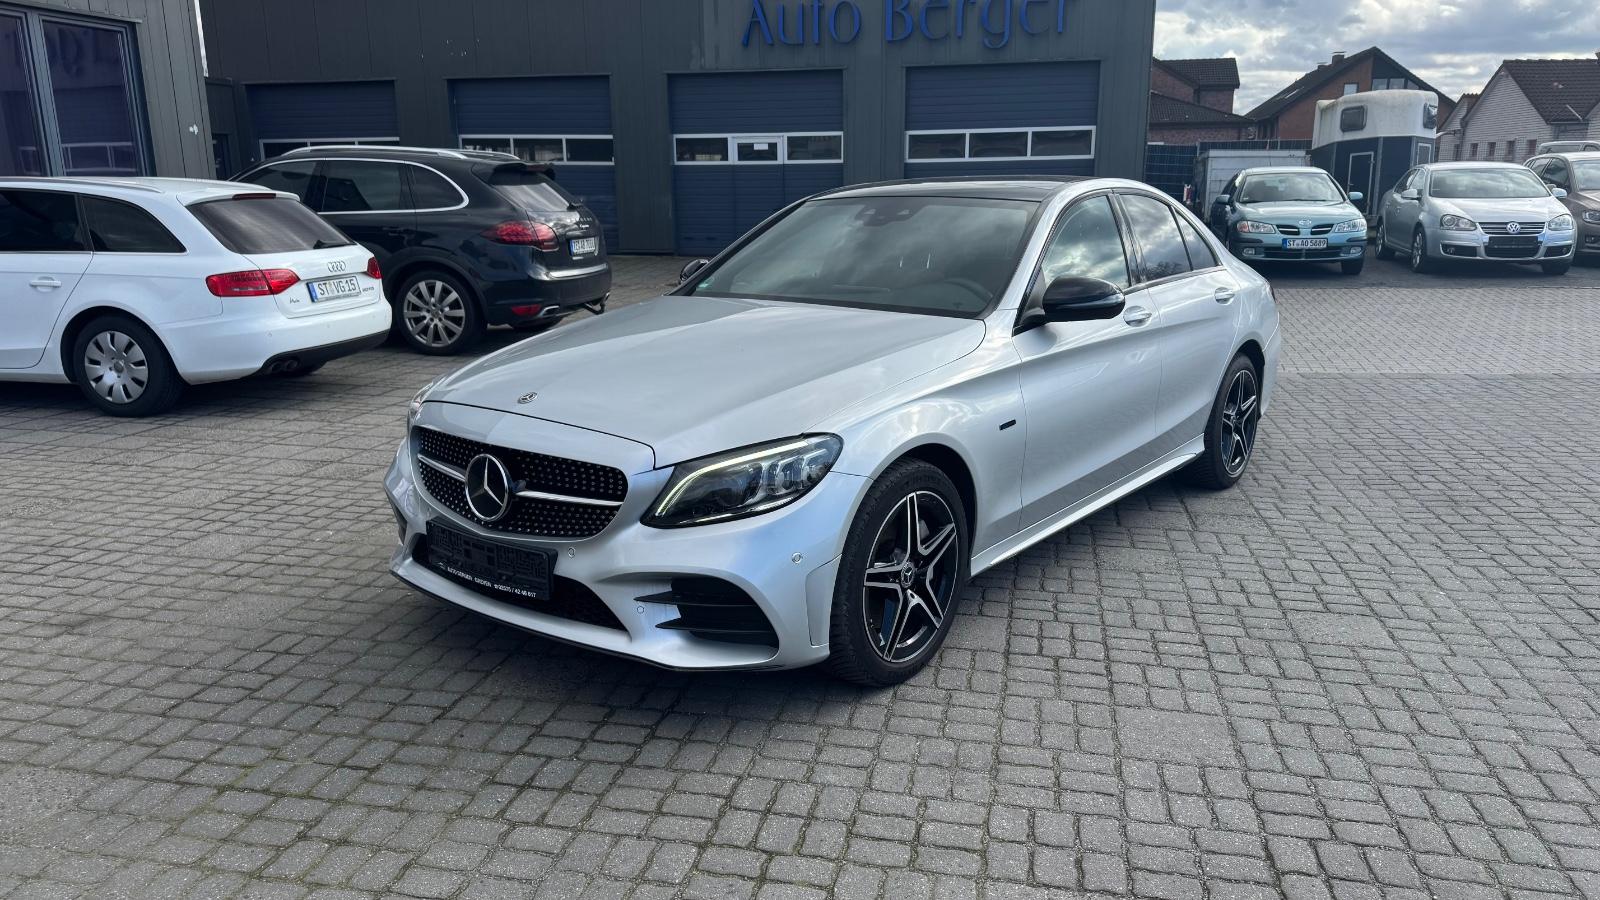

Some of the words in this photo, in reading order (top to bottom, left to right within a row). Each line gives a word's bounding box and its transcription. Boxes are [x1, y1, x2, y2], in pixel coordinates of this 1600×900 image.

[742, 0, 862, 47] Auto
[885, 0, 1076, 49] Berger
[1287, 239, 1296, 247] ST
[1300, 239, 1309, 247] AO
[317, 282, 329, 296] ST
[333, 280, 345, 293] VG
[346, 278, 357, 292] 15
